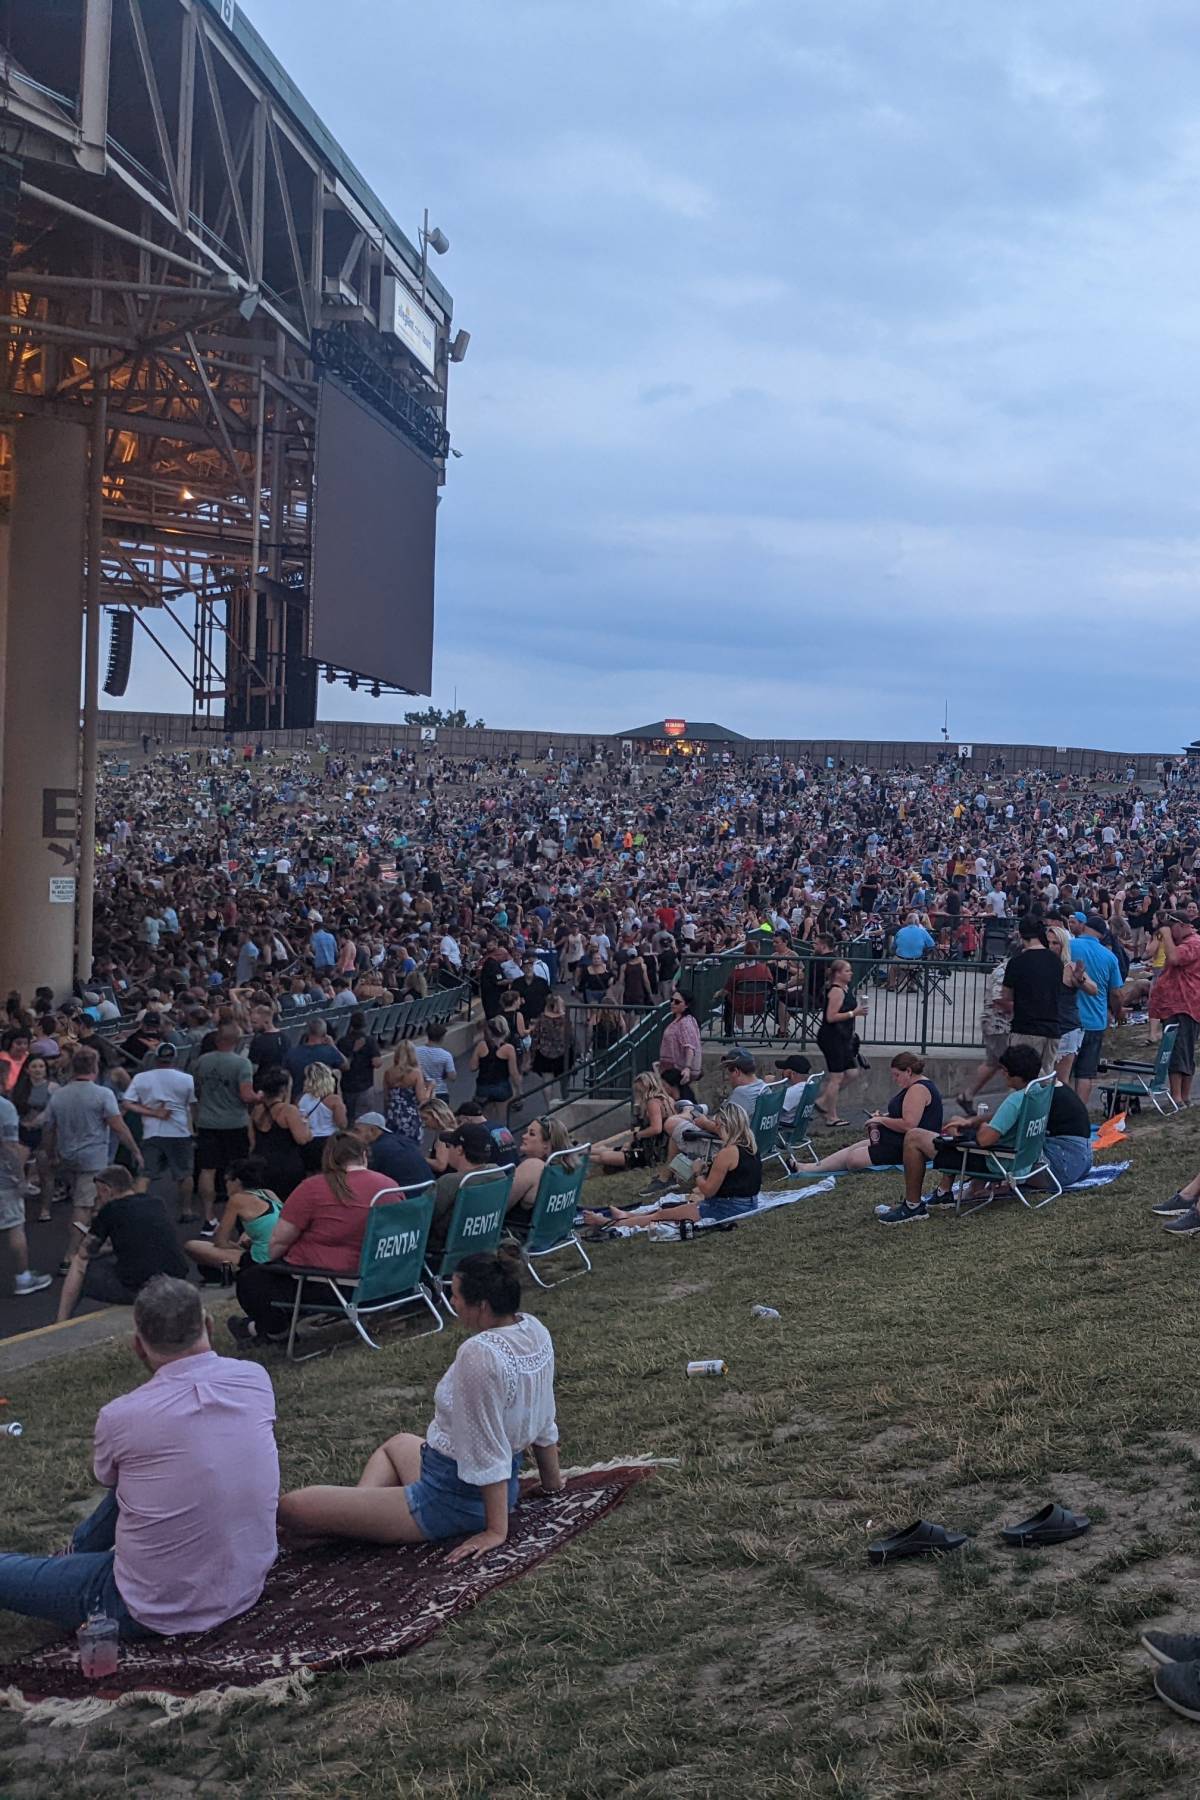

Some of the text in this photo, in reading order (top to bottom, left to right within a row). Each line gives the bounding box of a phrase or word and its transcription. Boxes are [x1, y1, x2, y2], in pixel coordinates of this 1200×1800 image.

[425, 729, 432, 739] 2
[961, 746, 968, 757] 3
[43, 788, 77, 838] E
